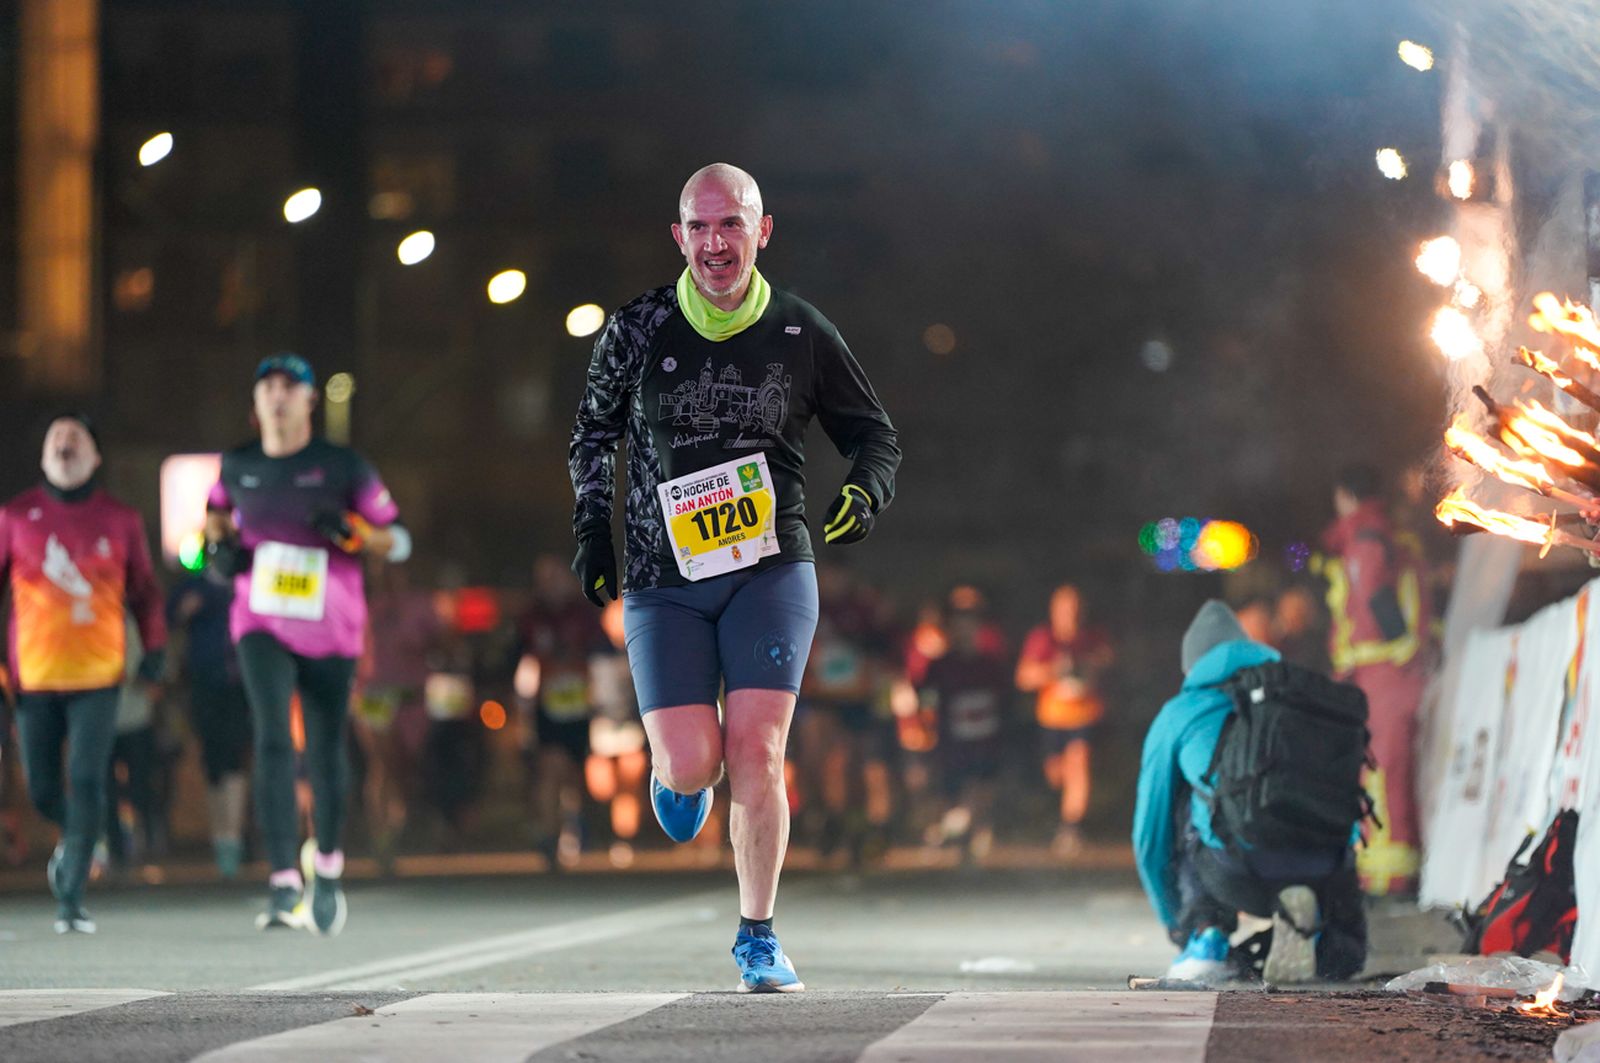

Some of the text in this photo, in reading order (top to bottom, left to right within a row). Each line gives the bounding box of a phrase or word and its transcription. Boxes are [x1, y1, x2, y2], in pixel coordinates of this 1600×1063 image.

[683, 481, 715, 498] NOCHE
[717, 475, 730, 487] DE
[675, 502, 695, 515] SAN
[698, 487, 734, 508] ANTÓN
[691, 497, 758, 541] 1720
[718, 532, 746, 547] ANDRES
